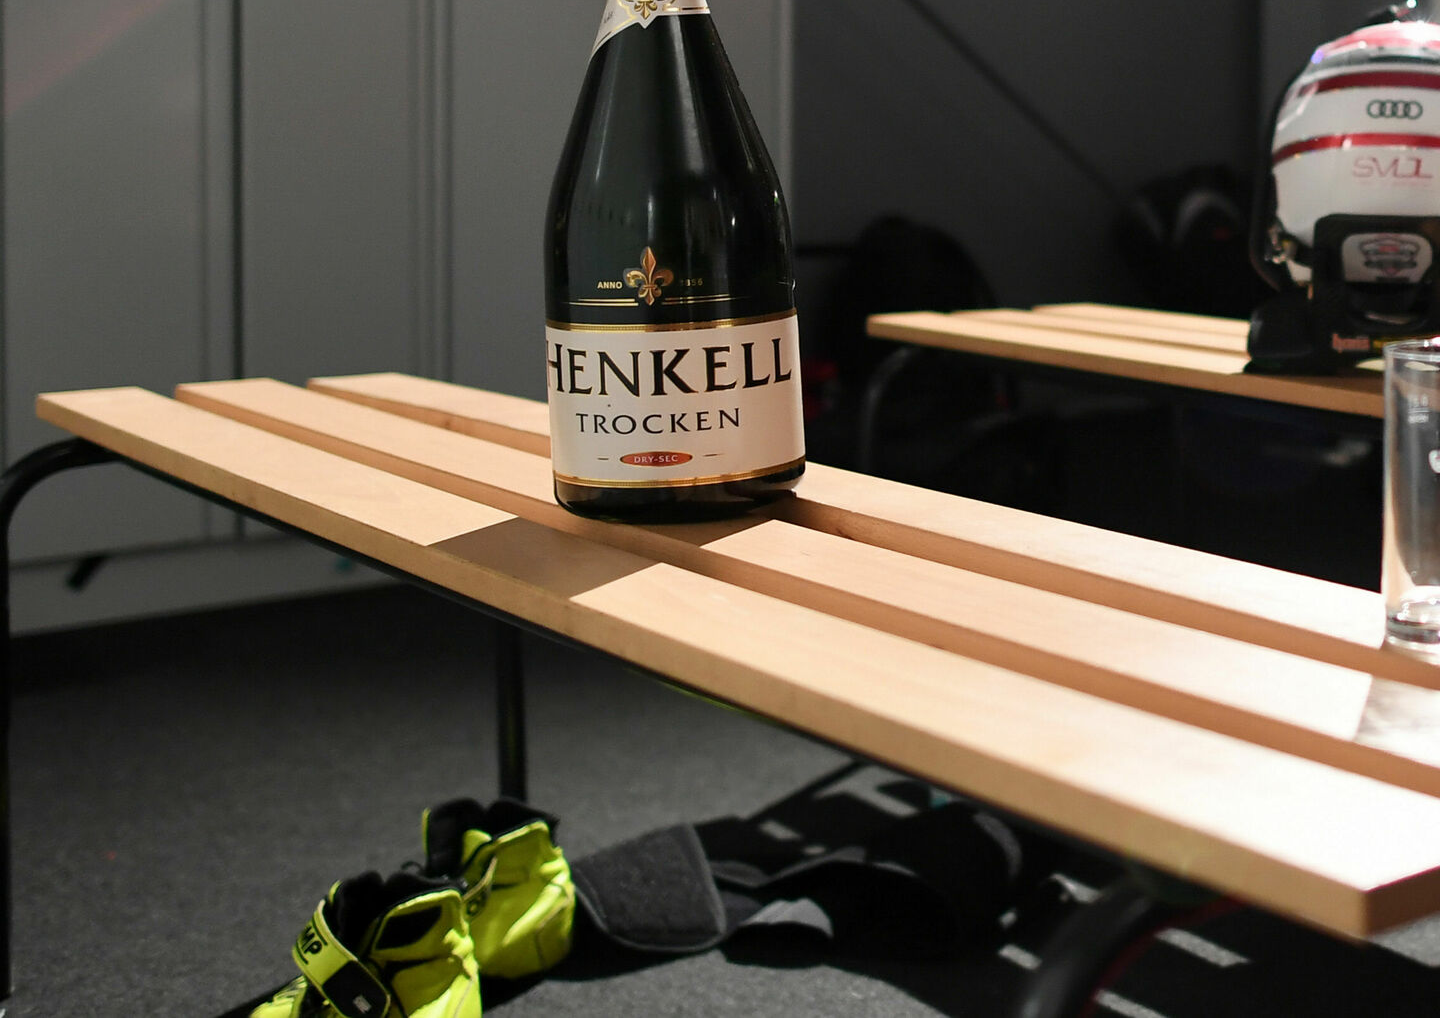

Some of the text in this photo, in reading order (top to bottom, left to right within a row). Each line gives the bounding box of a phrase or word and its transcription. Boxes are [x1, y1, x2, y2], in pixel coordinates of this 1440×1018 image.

[597, 281, 623, 290] ANNO
[546, 337, 792, 398] HENKELL
[575, 407, 741, 435] TROCKEN
[633, 453, 679, 464] DRY-SEC
[300, 925, 323, 955] MP
